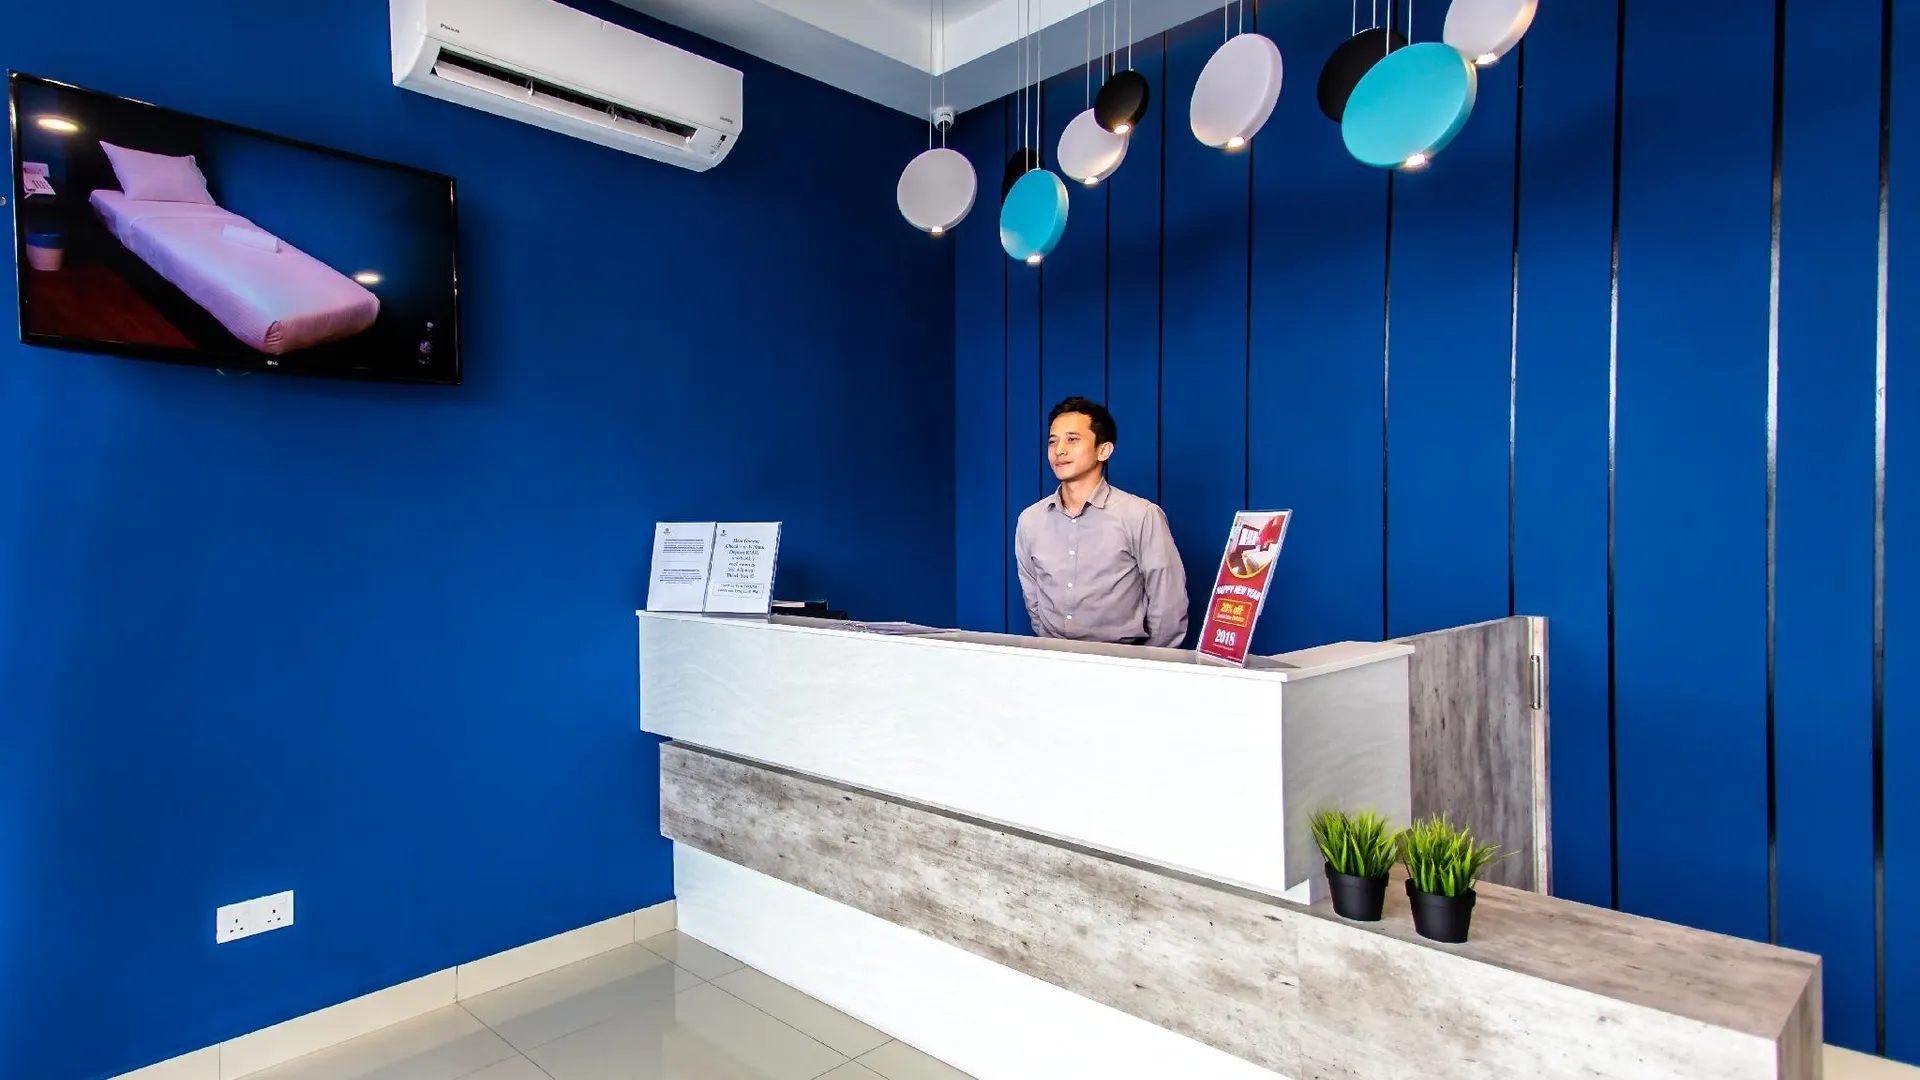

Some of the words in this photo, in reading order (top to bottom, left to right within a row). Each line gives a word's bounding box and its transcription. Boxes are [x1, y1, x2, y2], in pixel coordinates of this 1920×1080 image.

[1216, 586, 1234, 595] HAPPY
[1234, 586, 1247, 595] NEW
[1215, 629, 1236, 646] 2018
